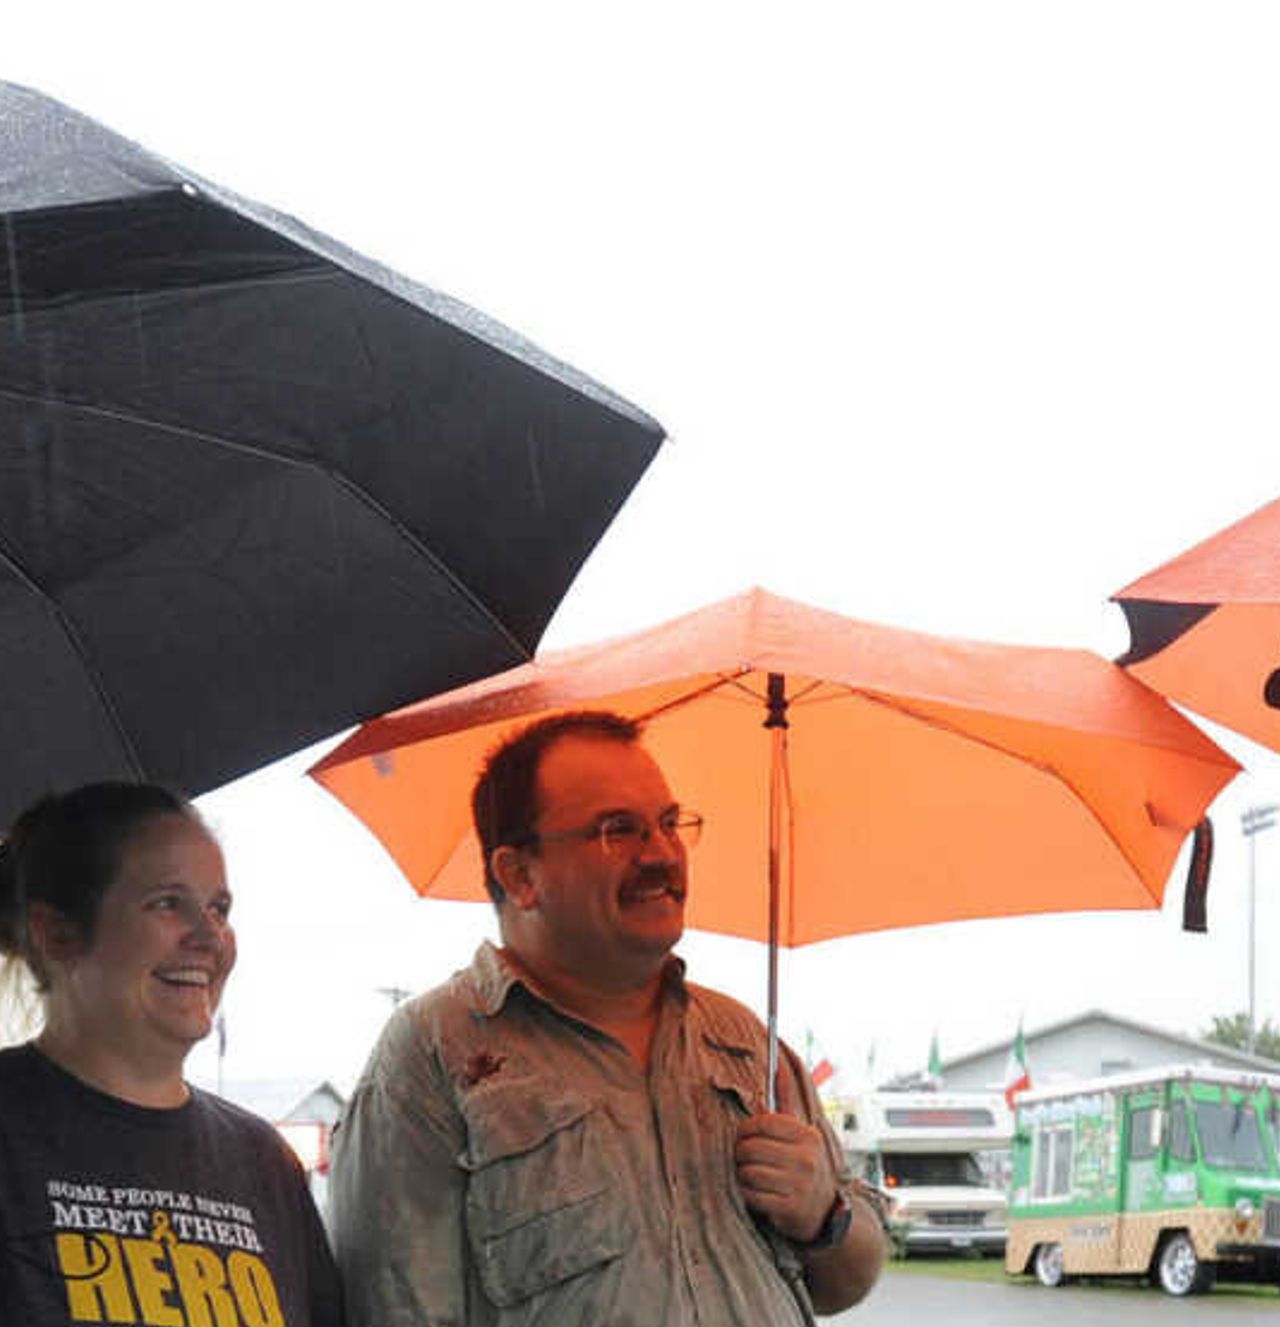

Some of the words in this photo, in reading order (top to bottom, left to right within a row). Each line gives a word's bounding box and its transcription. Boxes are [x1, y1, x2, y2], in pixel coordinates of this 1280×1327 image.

[47, 1181, 112, 1202] SOME
[113, 1187, 194, 1211] PEOPLE
[194, 1197, 254, 1223] NEVER
[52, 1201, 149, 1235] MEET
[173, 1211, 264, 1253] THEIR
